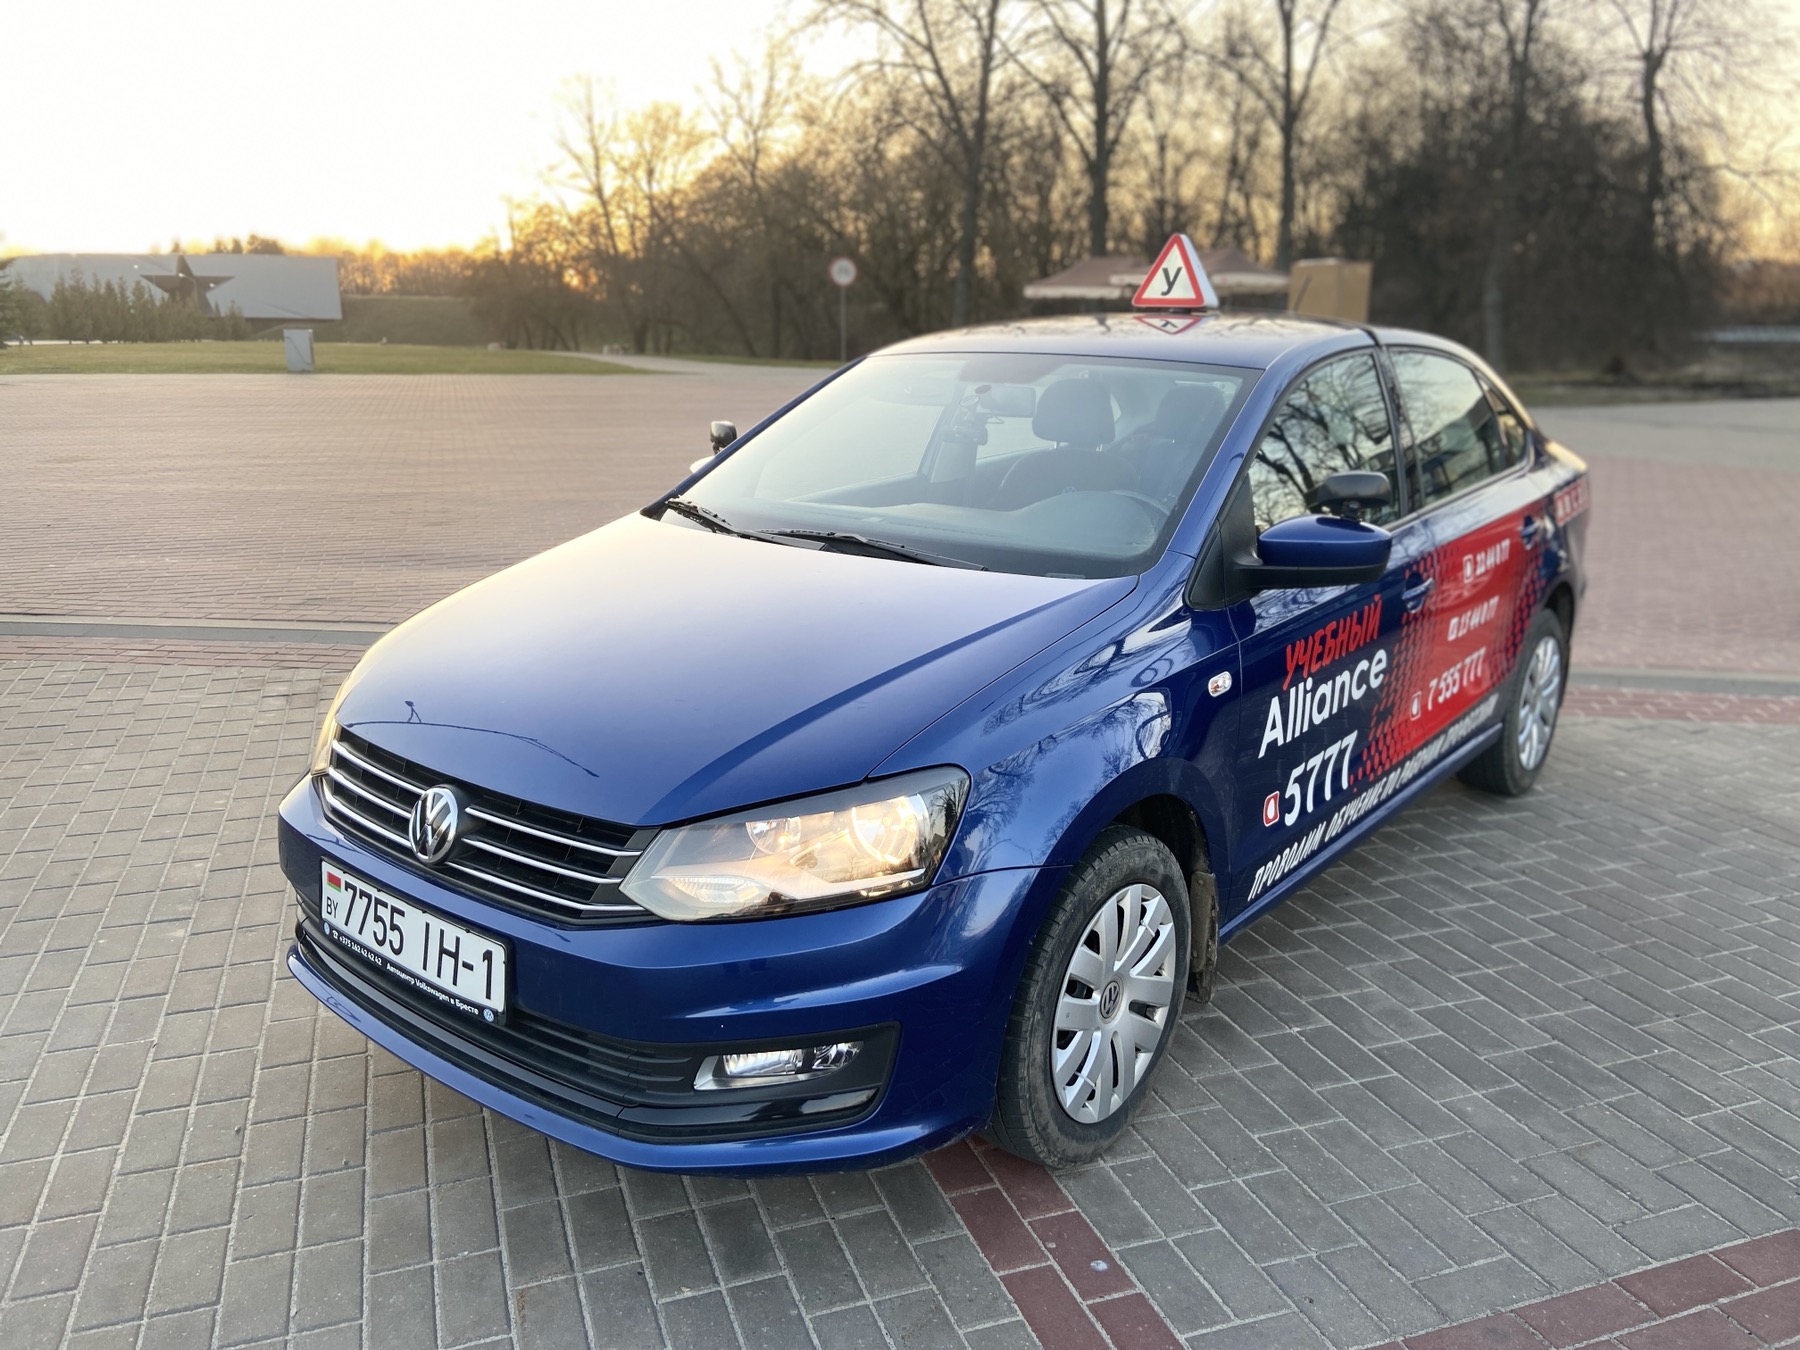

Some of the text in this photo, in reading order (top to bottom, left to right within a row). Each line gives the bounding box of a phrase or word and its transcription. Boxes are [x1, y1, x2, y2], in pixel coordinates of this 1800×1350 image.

[1282, 594, 1383, 690] УЧЕБНЫЙ
[1428, 646, 1487, 711] 7 555 777
[1258, 649, 1388, 759] Alliance
[1284, 730, 1358, 827] 5777
[1247, 820, 1327, 902] ПРОВОДИМ
[1324, 777, 1387, 843] ОБУЧЕНИЕ
[326, 896, 339, 919] BY
[344, 880, 493, 1000] 7755 IH-1
[414, 979, 450, 1002] Volkswagen
[455, 999, 479, 1016] Бресте
